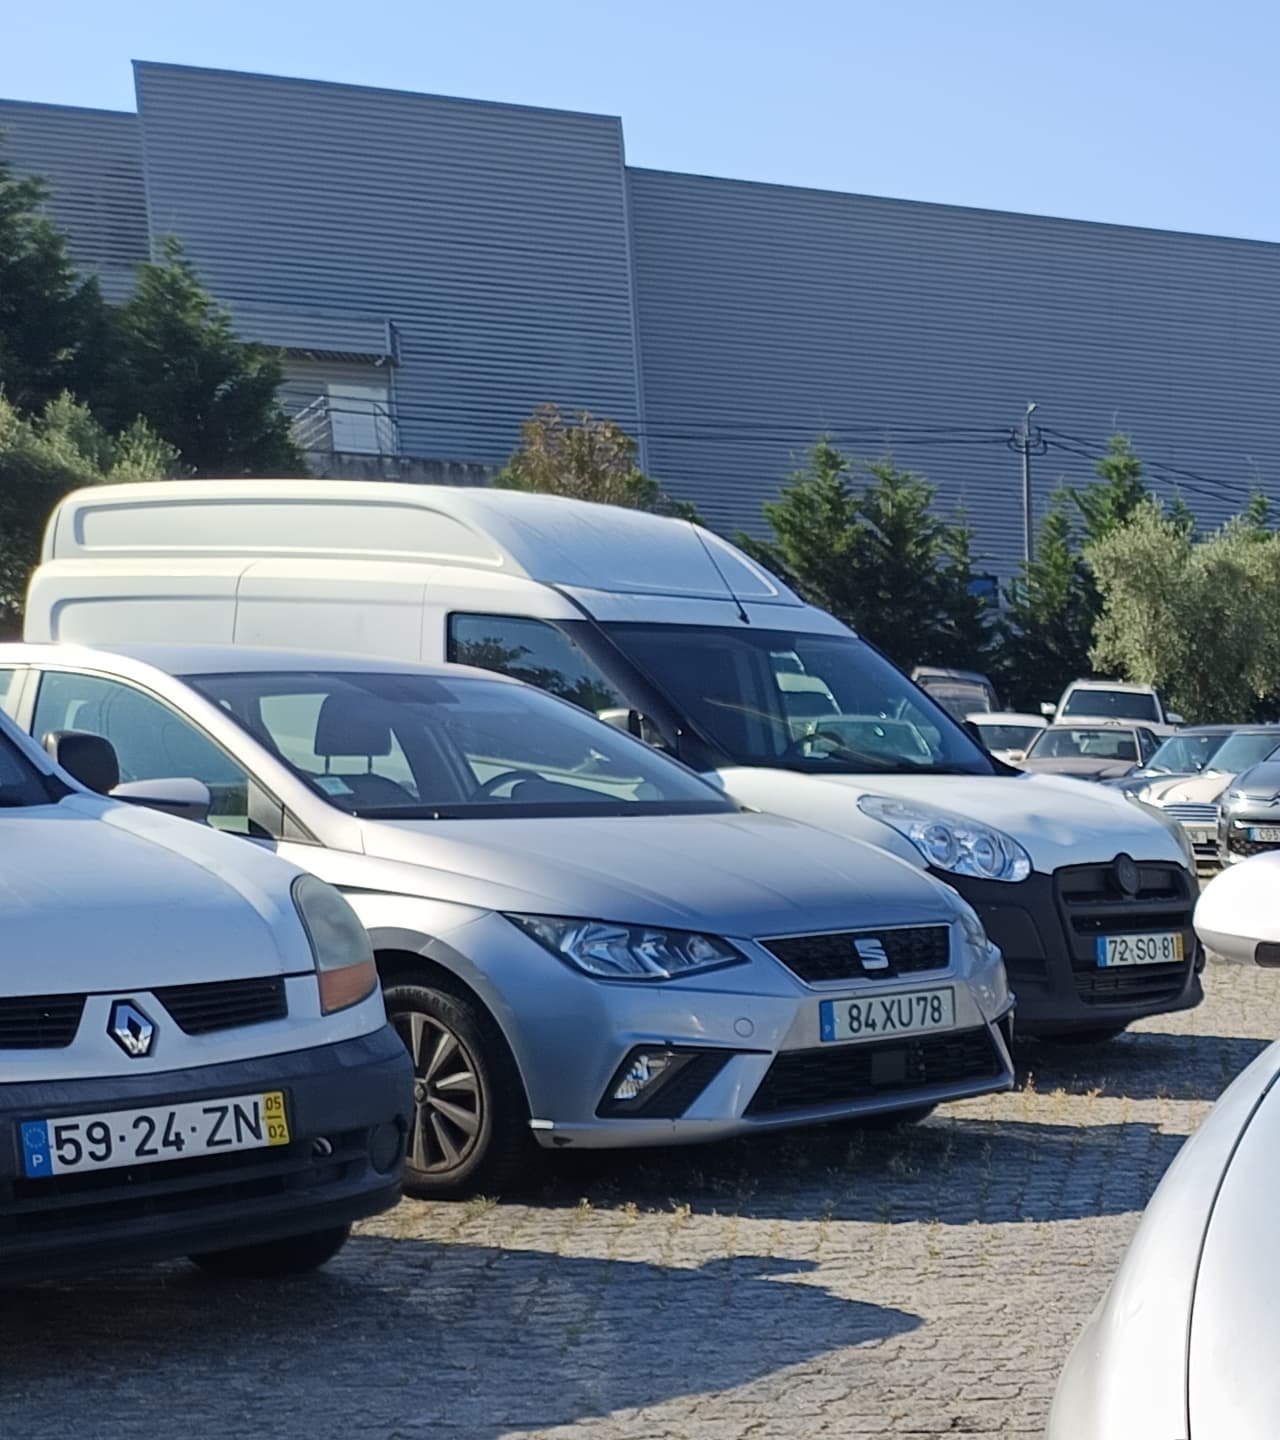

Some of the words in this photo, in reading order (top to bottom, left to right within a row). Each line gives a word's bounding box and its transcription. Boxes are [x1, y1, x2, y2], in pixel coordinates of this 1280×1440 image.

[265, 1096, 282, 1111] 05
[268, 1123, 287, 1139] 02
[32, 1154, 44, 1168] P
